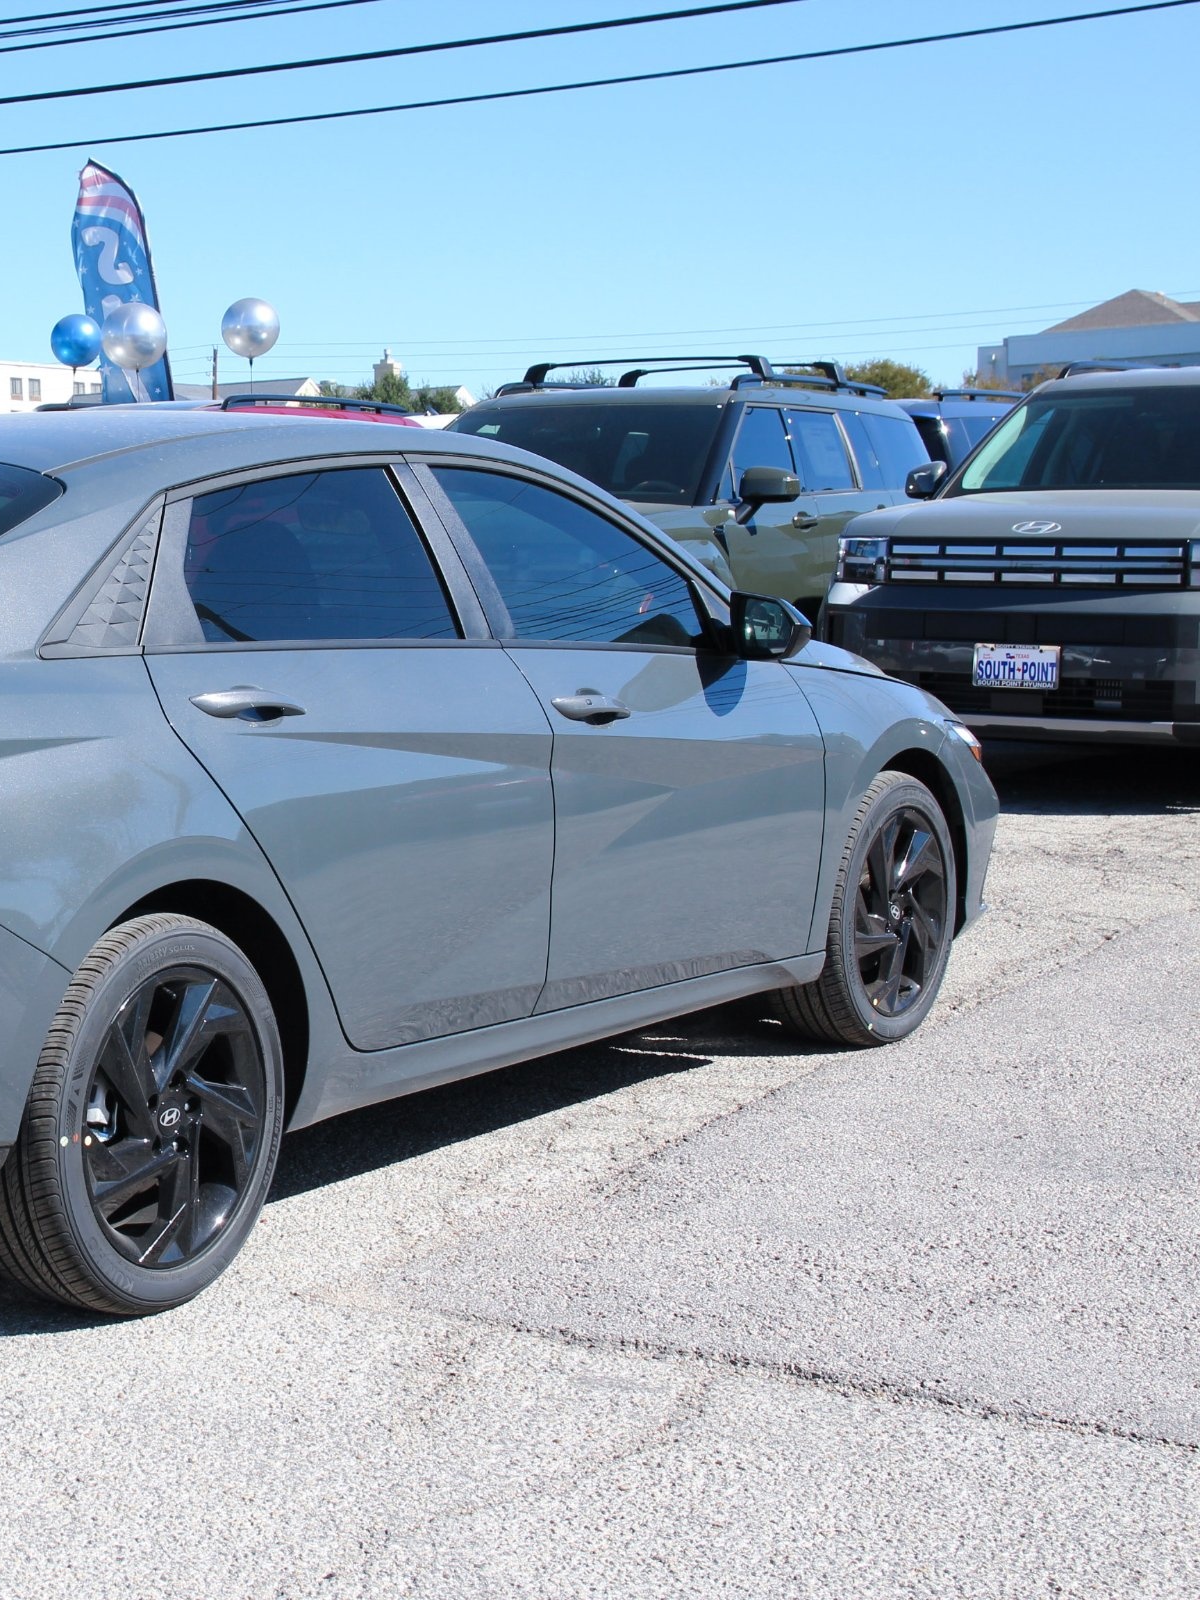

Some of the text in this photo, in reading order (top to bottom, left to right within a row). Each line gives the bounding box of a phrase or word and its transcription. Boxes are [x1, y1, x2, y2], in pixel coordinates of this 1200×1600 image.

[977, 660, 1057, 682] SOUTH POINT
[169, 944, 196, 953] SOLUS
